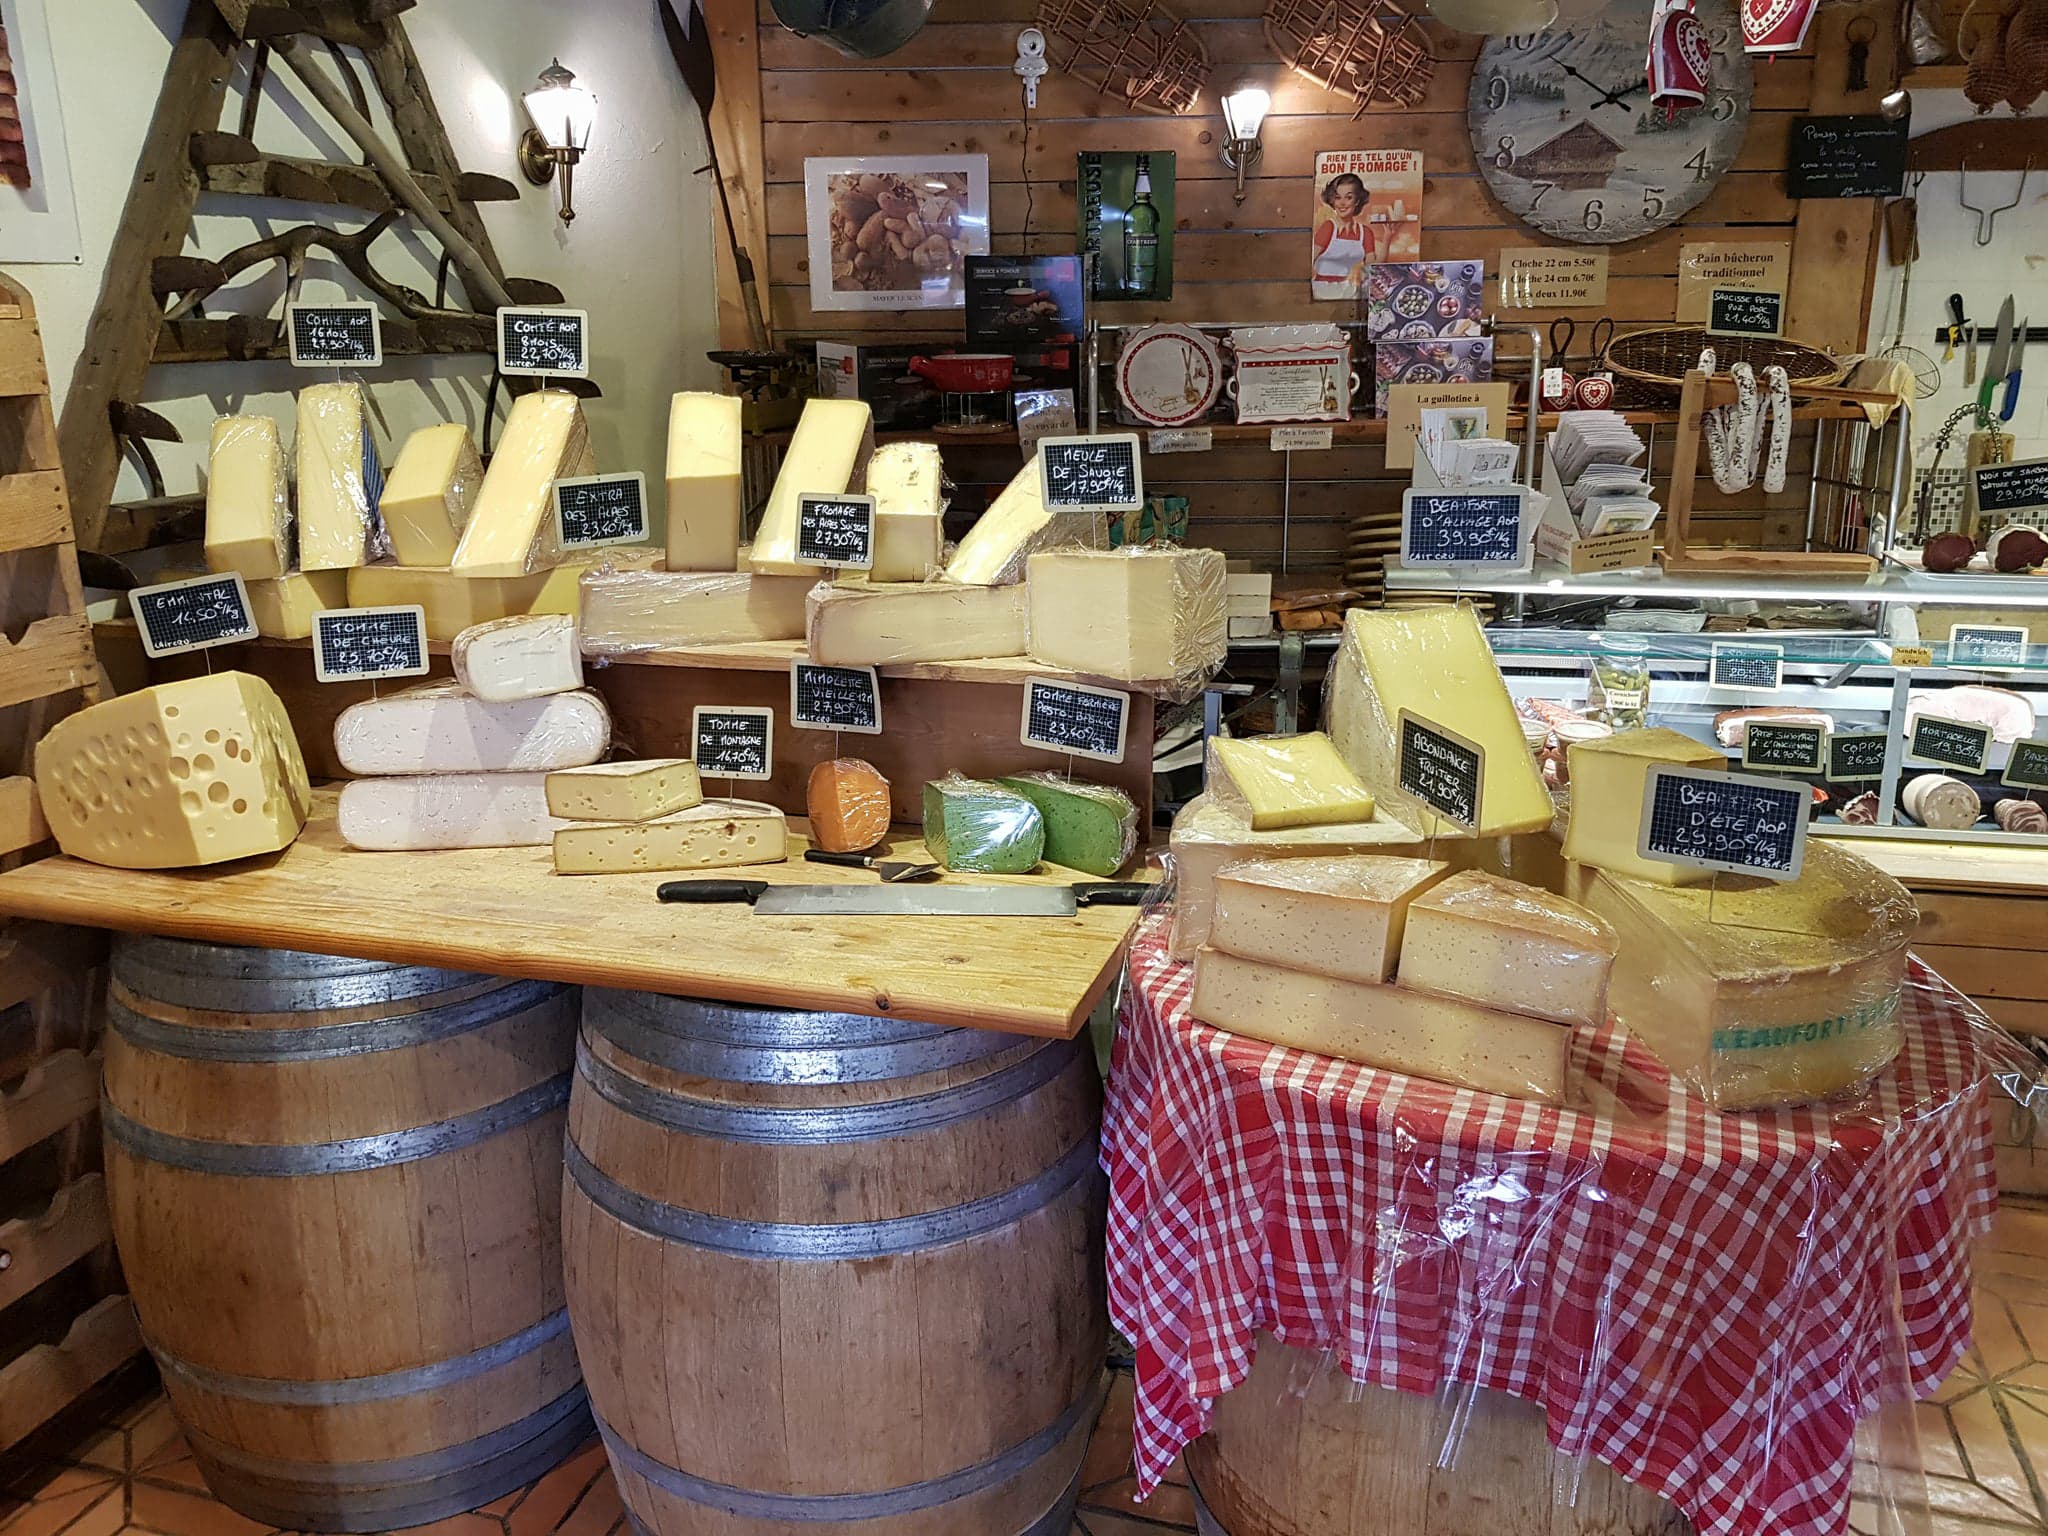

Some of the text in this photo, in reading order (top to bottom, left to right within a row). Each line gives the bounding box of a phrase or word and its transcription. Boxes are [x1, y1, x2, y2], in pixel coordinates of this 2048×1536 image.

[1486, 76, 1509, 111] 9
[1326, 151, 1412, 162] RIEN DE TEL QU'UN
[1495, 136, 1516, 169] 8
[1321, 162, 1345, 173] BON
[1350, 161, 1408, 173] FROMAGE
[1682, 146, 1712, 184] 4
[1531, 181, 1554, 212] 7
[1641, 187, 1665, 220] 5
[1086, 151, 1102, 291] RTREUSE
[1583, 199, 1603, 231] 6
[1511, 260, 1543, 268] Cloche
[1545, 259, 1556, 268] 22
[1574, 258, 1596, 267] 5.50€
[1697, 252, 1773, 263] Pain bûcheron
[1544, 275, 1555, 283] 24
[1573, 273, 1595, 282] 6.70€
[1703, 267, 1766, 278] traditionnel
[1536, 289, 1557, 297] deux
[1560, 288, 1587, 297] 11.90€
[1715, 292, 1751, 303] SAUCISSE
[514, 318, 578, 333] COMTÉ AOP
[1417, 394, 1429, 403] La
[1431, 394, 1473, 404] guillotine
[1064, 448, 1108, 463] MEULE
[1053, 464, 1127, 479] DE SAVOIE
[576, 488, 623, 505] EXTRA
[565, 506, 630, 522] DES ALPES
[815, 504, 856, 517] FROMAGE
[333, 637, 355, 648] DE
[805, 671, 863, 688] MIMOLETTE
[708, 718, 750, 730] TOMME
[700, 734, 762, 746] DE MONTAGNE
[1921, 726, 1978, 745] MORTADELLE
[1414, 732, 1471, 774] ABONDANCE
[1842, 742, 1884, 755] COPPA
[1418, 758, 1461, 791] FRUITIER
[1756, 818, 1787, 834] AOP
[1650, 842, 1678, 854] LAIT
[1682, 847, 1706, 859] CRU
